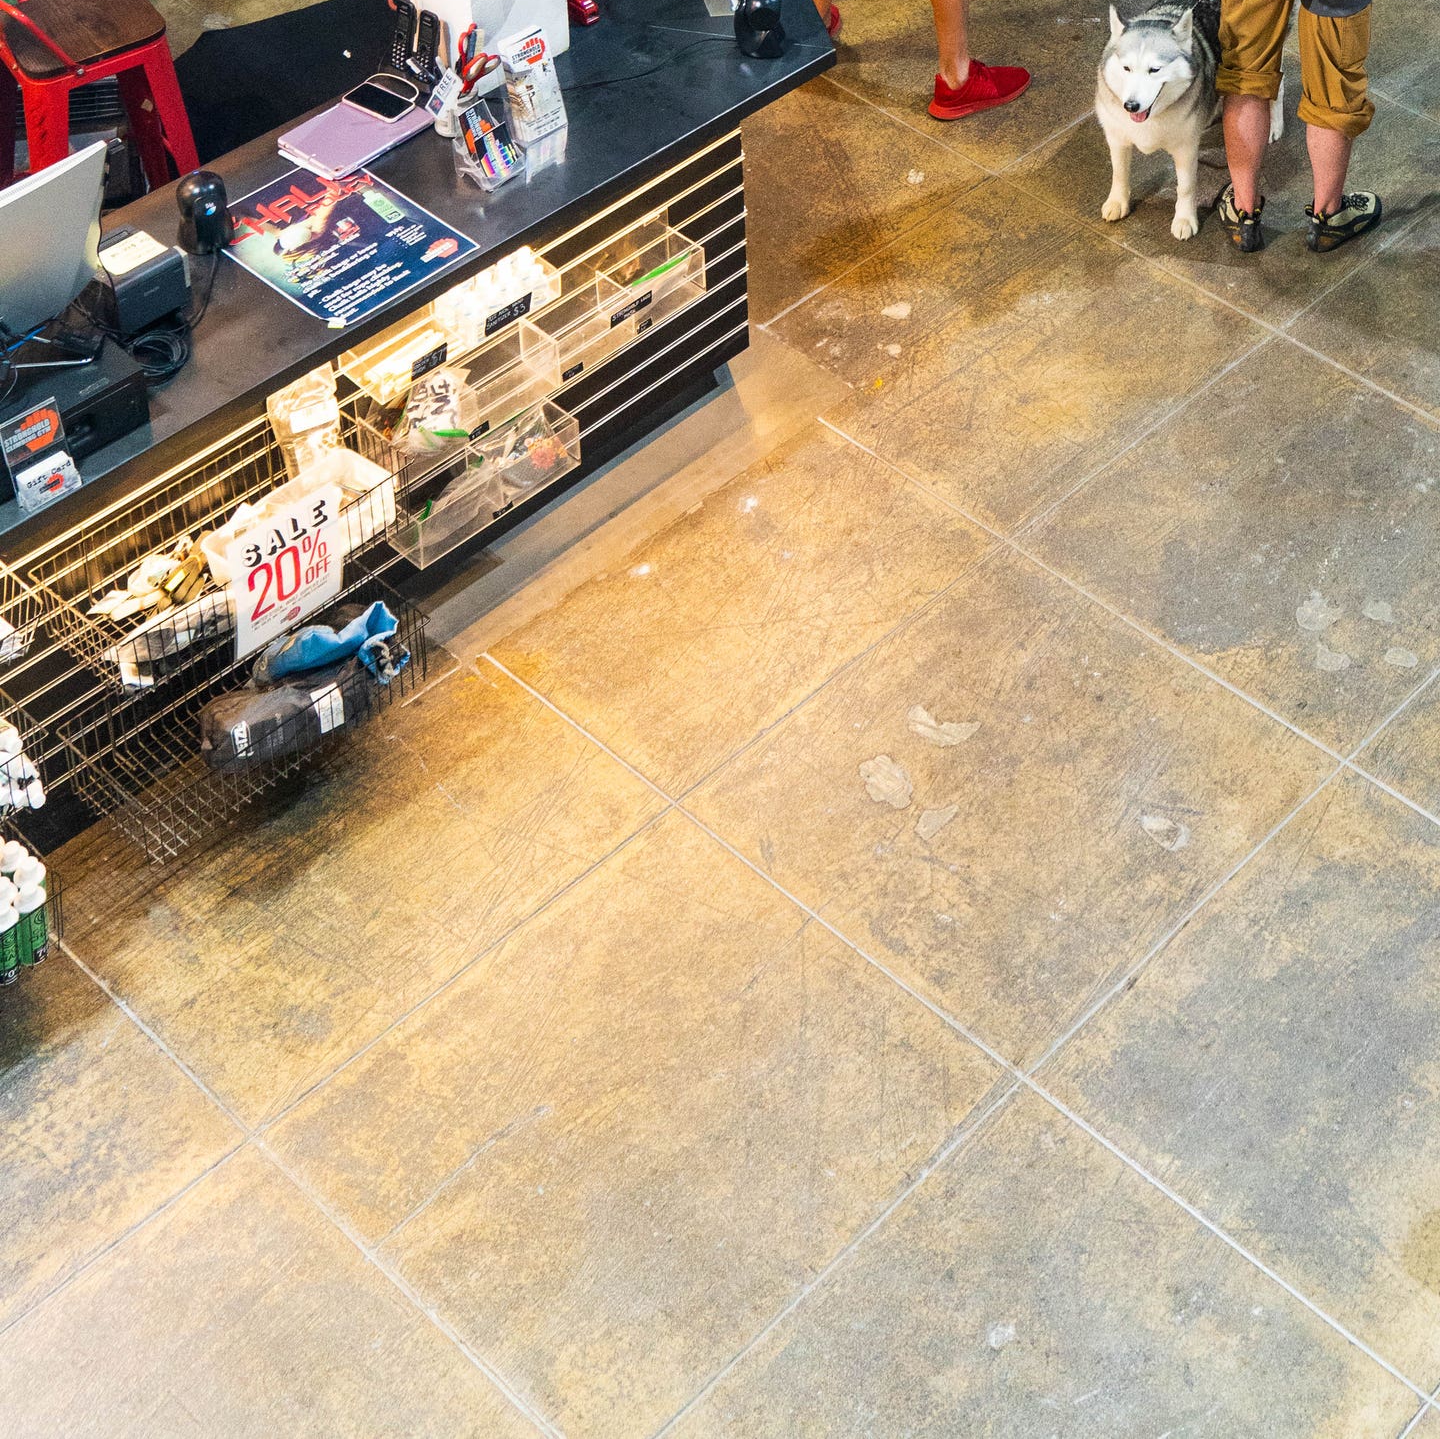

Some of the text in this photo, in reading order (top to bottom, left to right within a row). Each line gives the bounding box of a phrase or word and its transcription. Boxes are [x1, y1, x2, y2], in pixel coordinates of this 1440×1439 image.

[512, 43, 541, 62] STRONGHOLD
[437, 74, 452, 95] FREE
[4, 418, 51, 448] STRONGHOLD
[5, 431, 38, 453] CLIMBING
[26, 459, 71, 489] Gift Card
[241, 499, 329, 568] SALE
[305, 554, 331, 585] OFF
